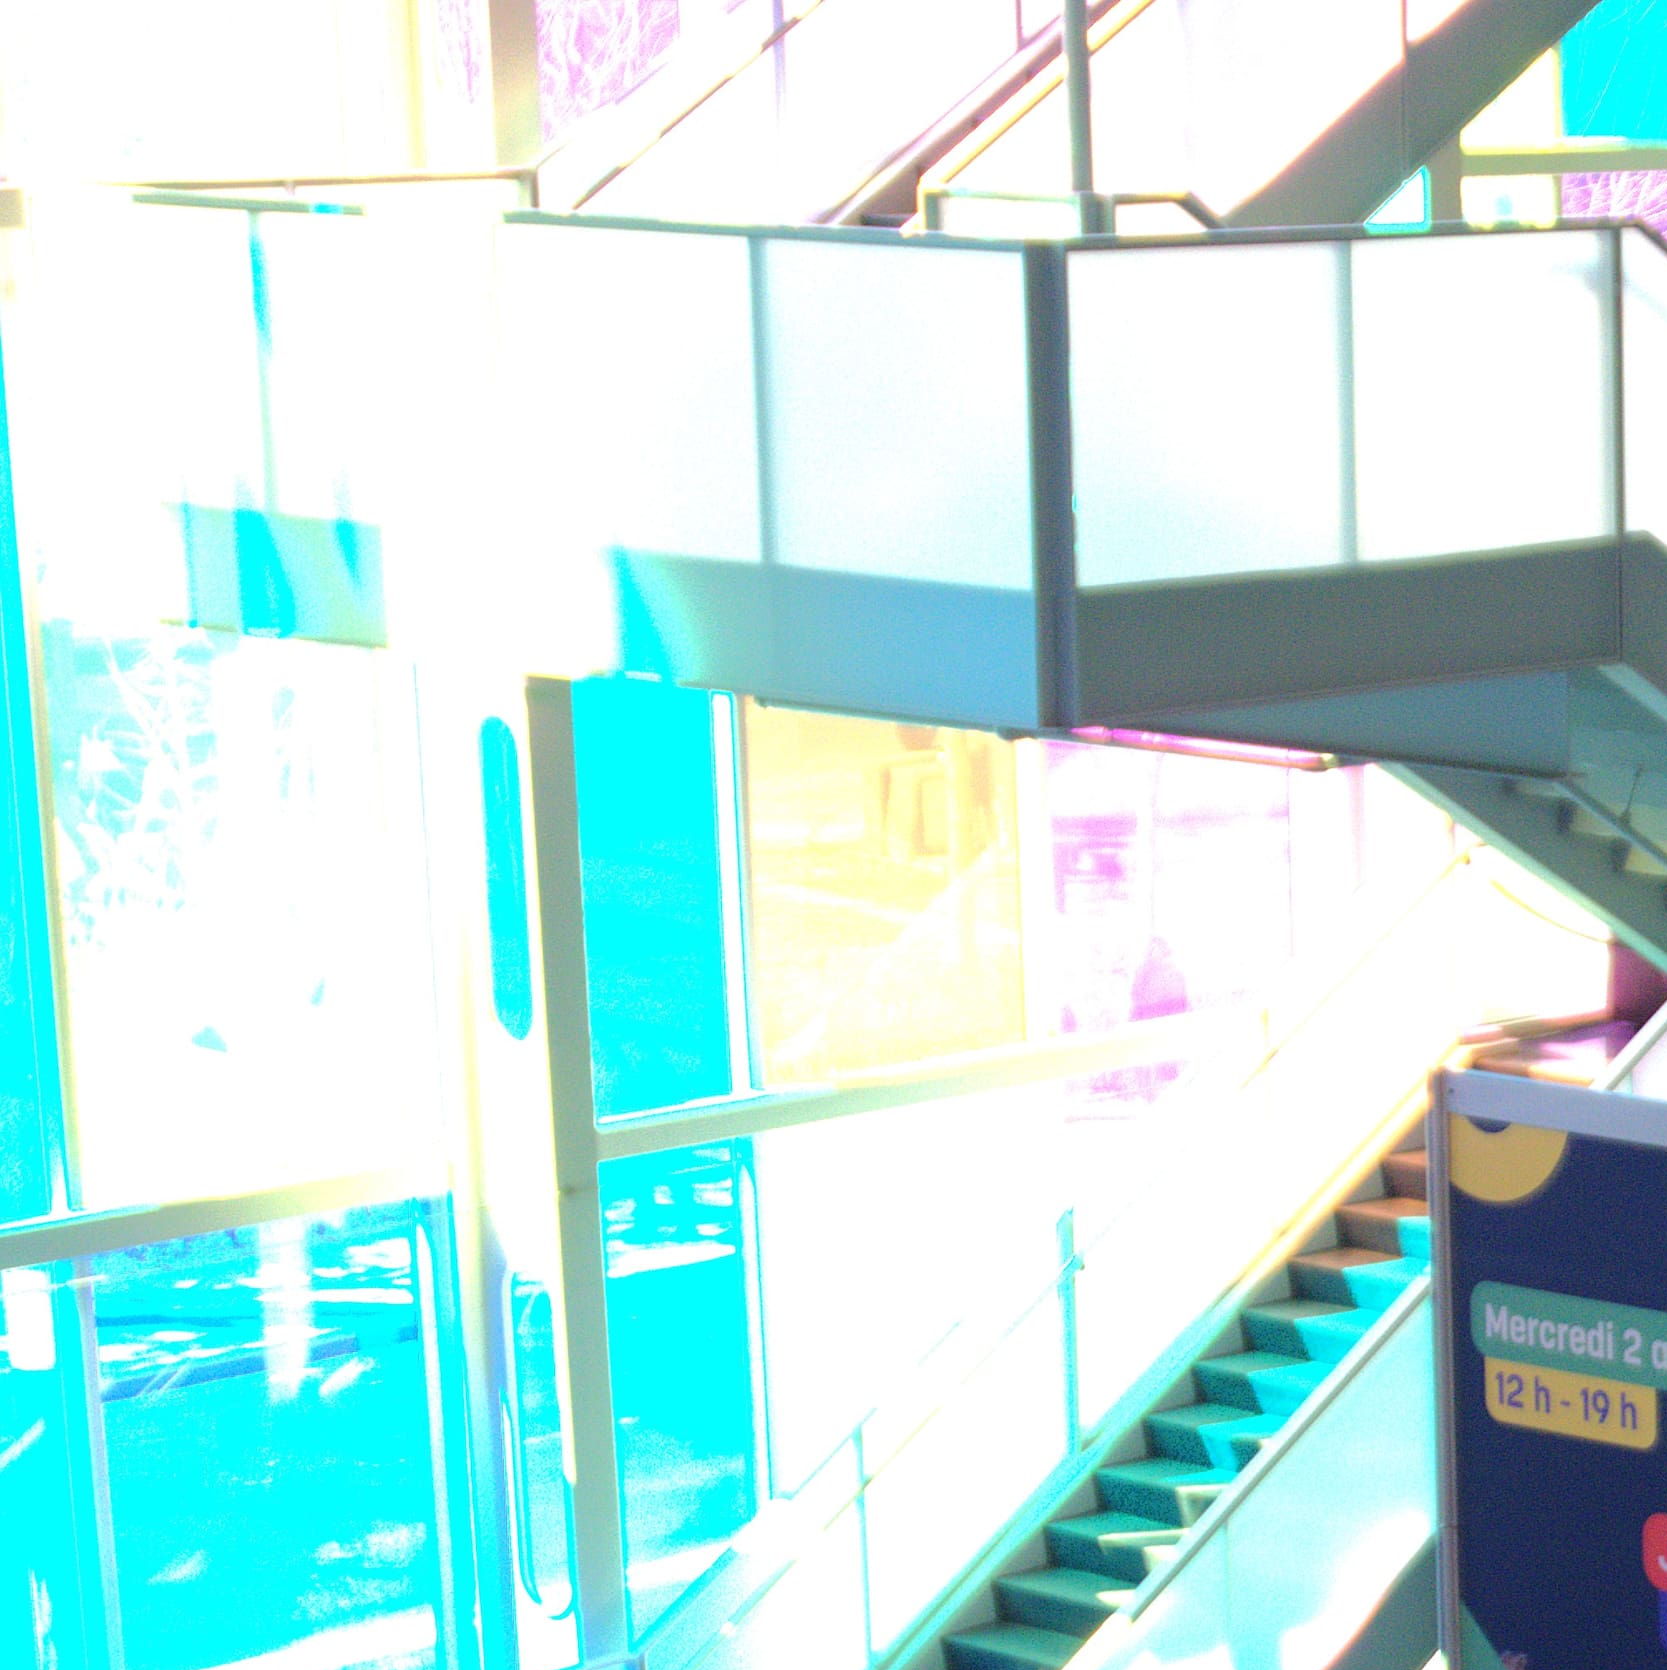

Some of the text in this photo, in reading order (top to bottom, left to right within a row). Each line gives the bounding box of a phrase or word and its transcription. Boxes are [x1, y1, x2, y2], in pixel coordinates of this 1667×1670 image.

[1484, 1302, 1614, 1360] Mercredi
[1623, 1327, 1642, 1365] 2
[1496, 1371, 1524, 1409] 12
[1534, 1376, 1550, 1414] h
[1580, 1387, 1610, 1424] 19
[1621, 1392, 1637, 1430] h
